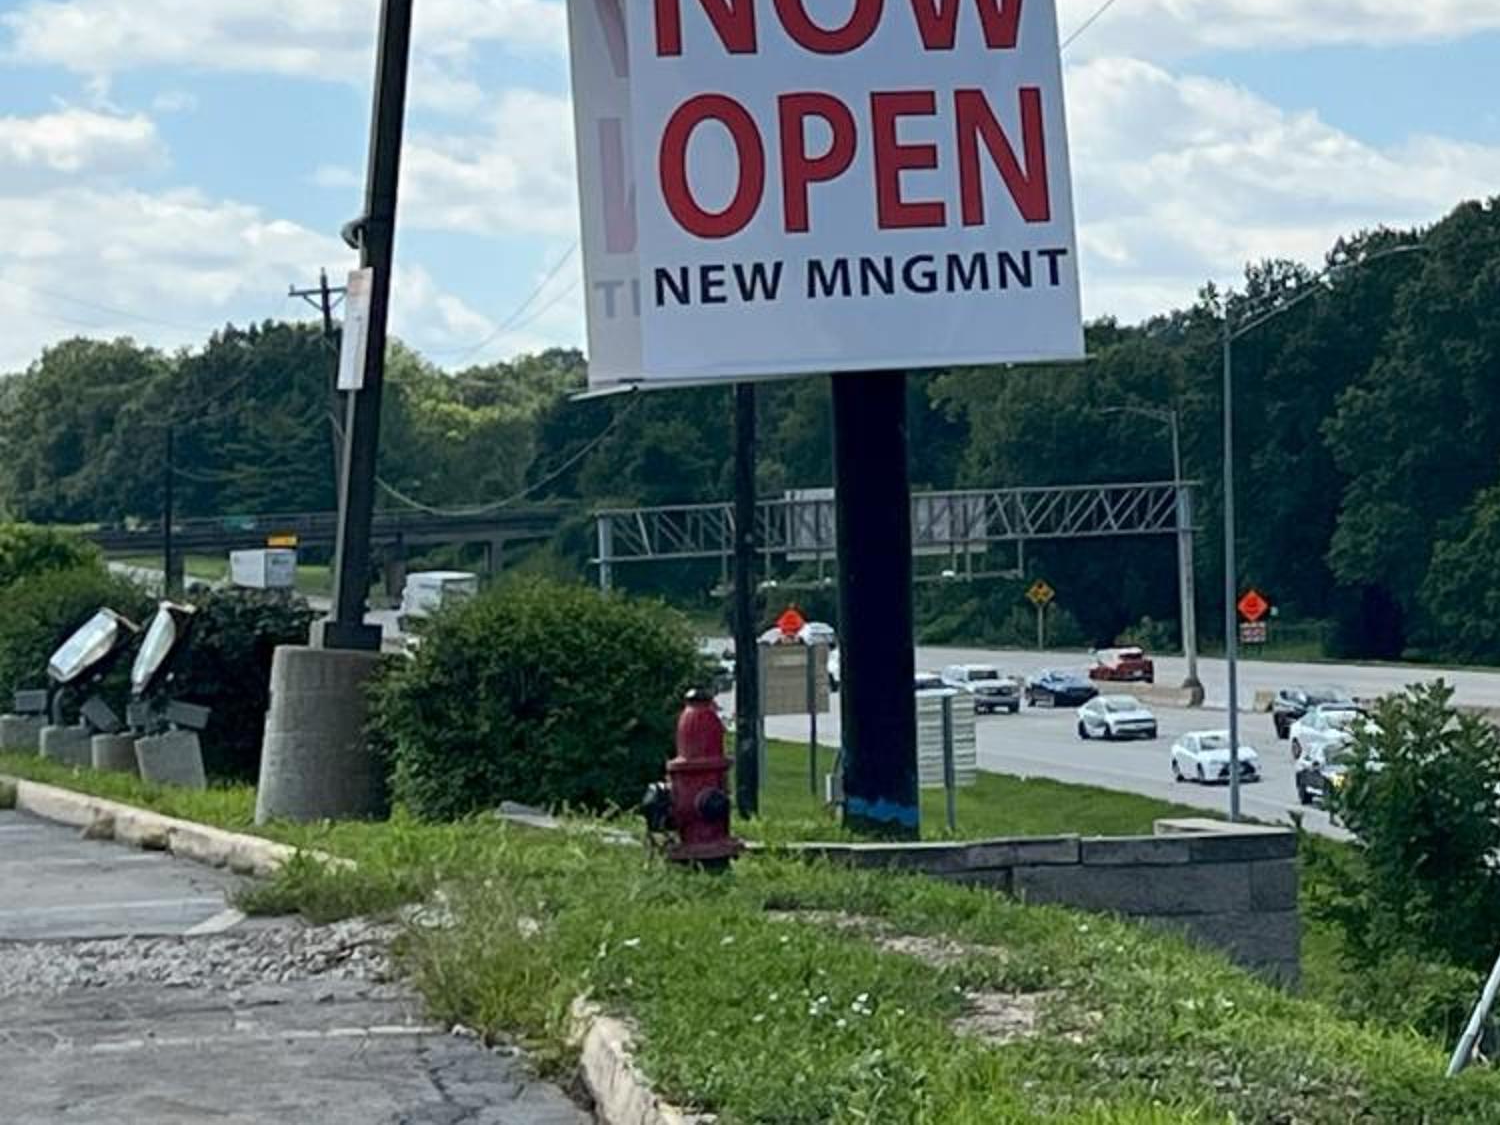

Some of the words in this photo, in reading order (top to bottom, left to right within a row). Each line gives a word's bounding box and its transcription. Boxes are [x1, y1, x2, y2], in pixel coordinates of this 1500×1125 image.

[658, 87, 1052, 239] OPEN
[654, 261, 784, 307] NEW
[806, 247, 1069, 299] MNGMNT
